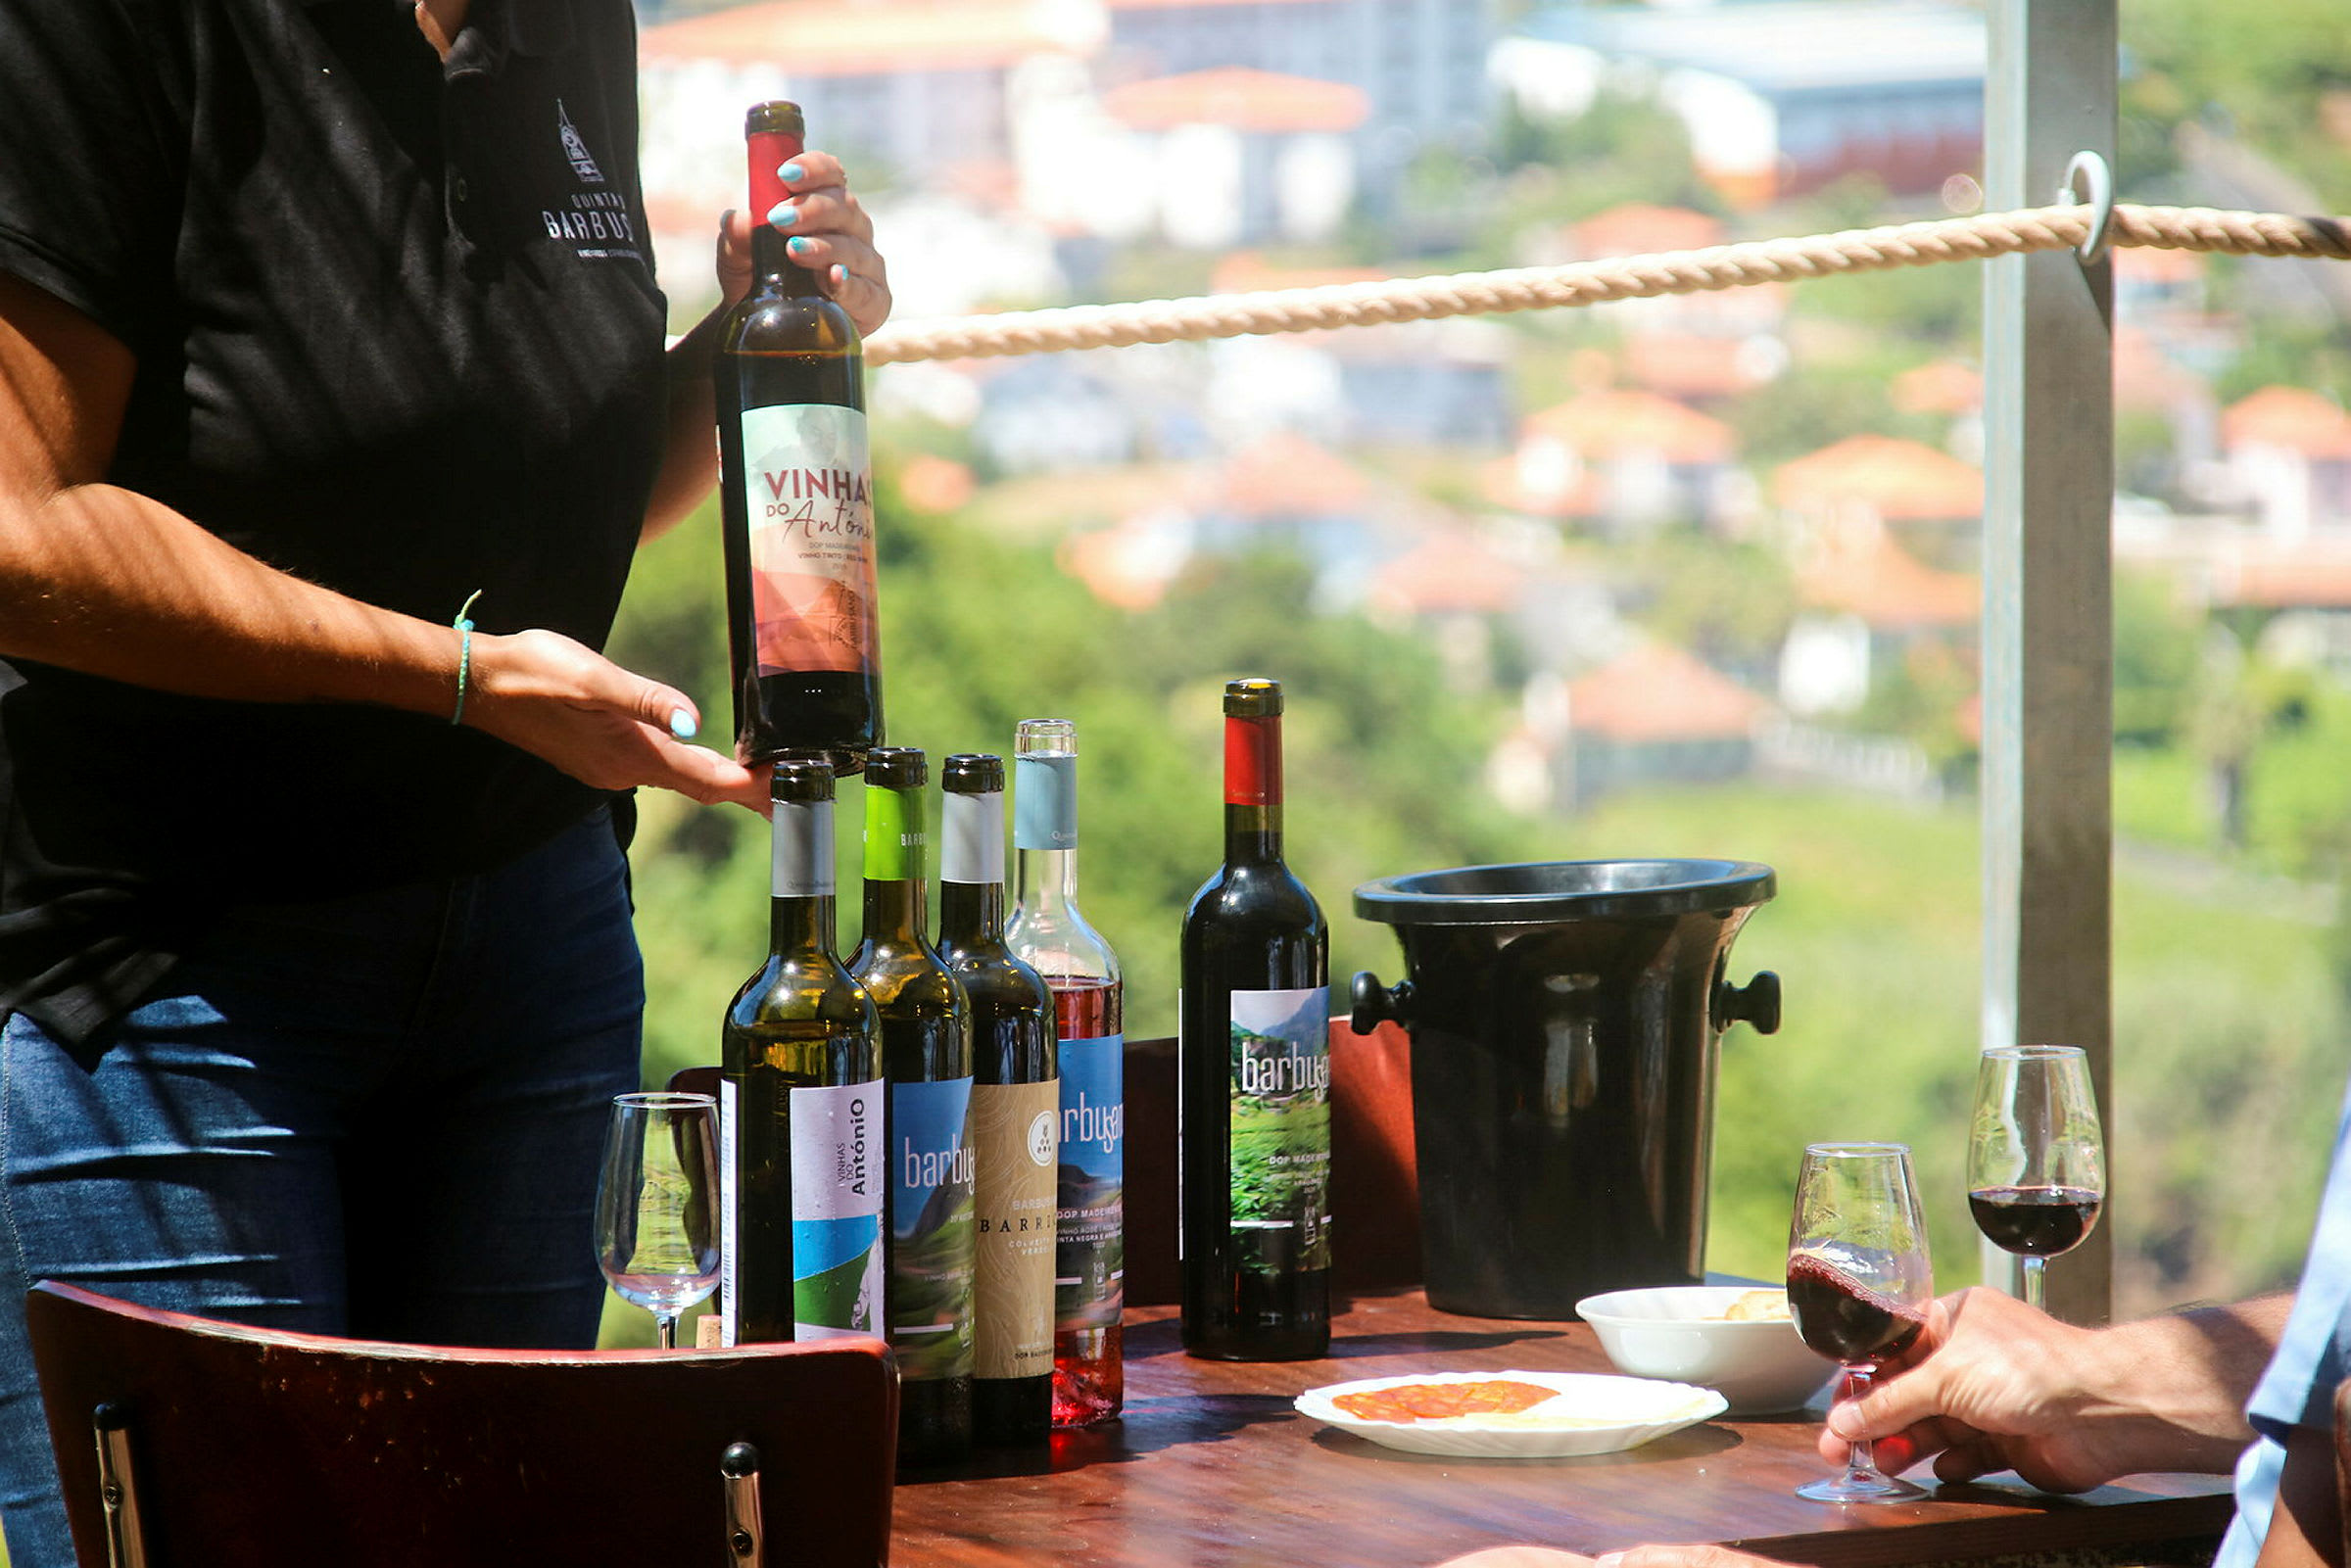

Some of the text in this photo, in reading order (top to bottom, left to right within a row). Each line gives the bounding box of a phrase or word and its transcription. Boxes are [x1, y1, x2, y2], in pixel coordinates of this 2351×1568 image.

[764, 468, 871, 508] VINHA
[766, 502, 790, 517] DO
[837, 1142, 846, 1182] VINHAS
[846, 1164, 854, 1180] DO
[980, 1214, 1057, 1233] BARRI
